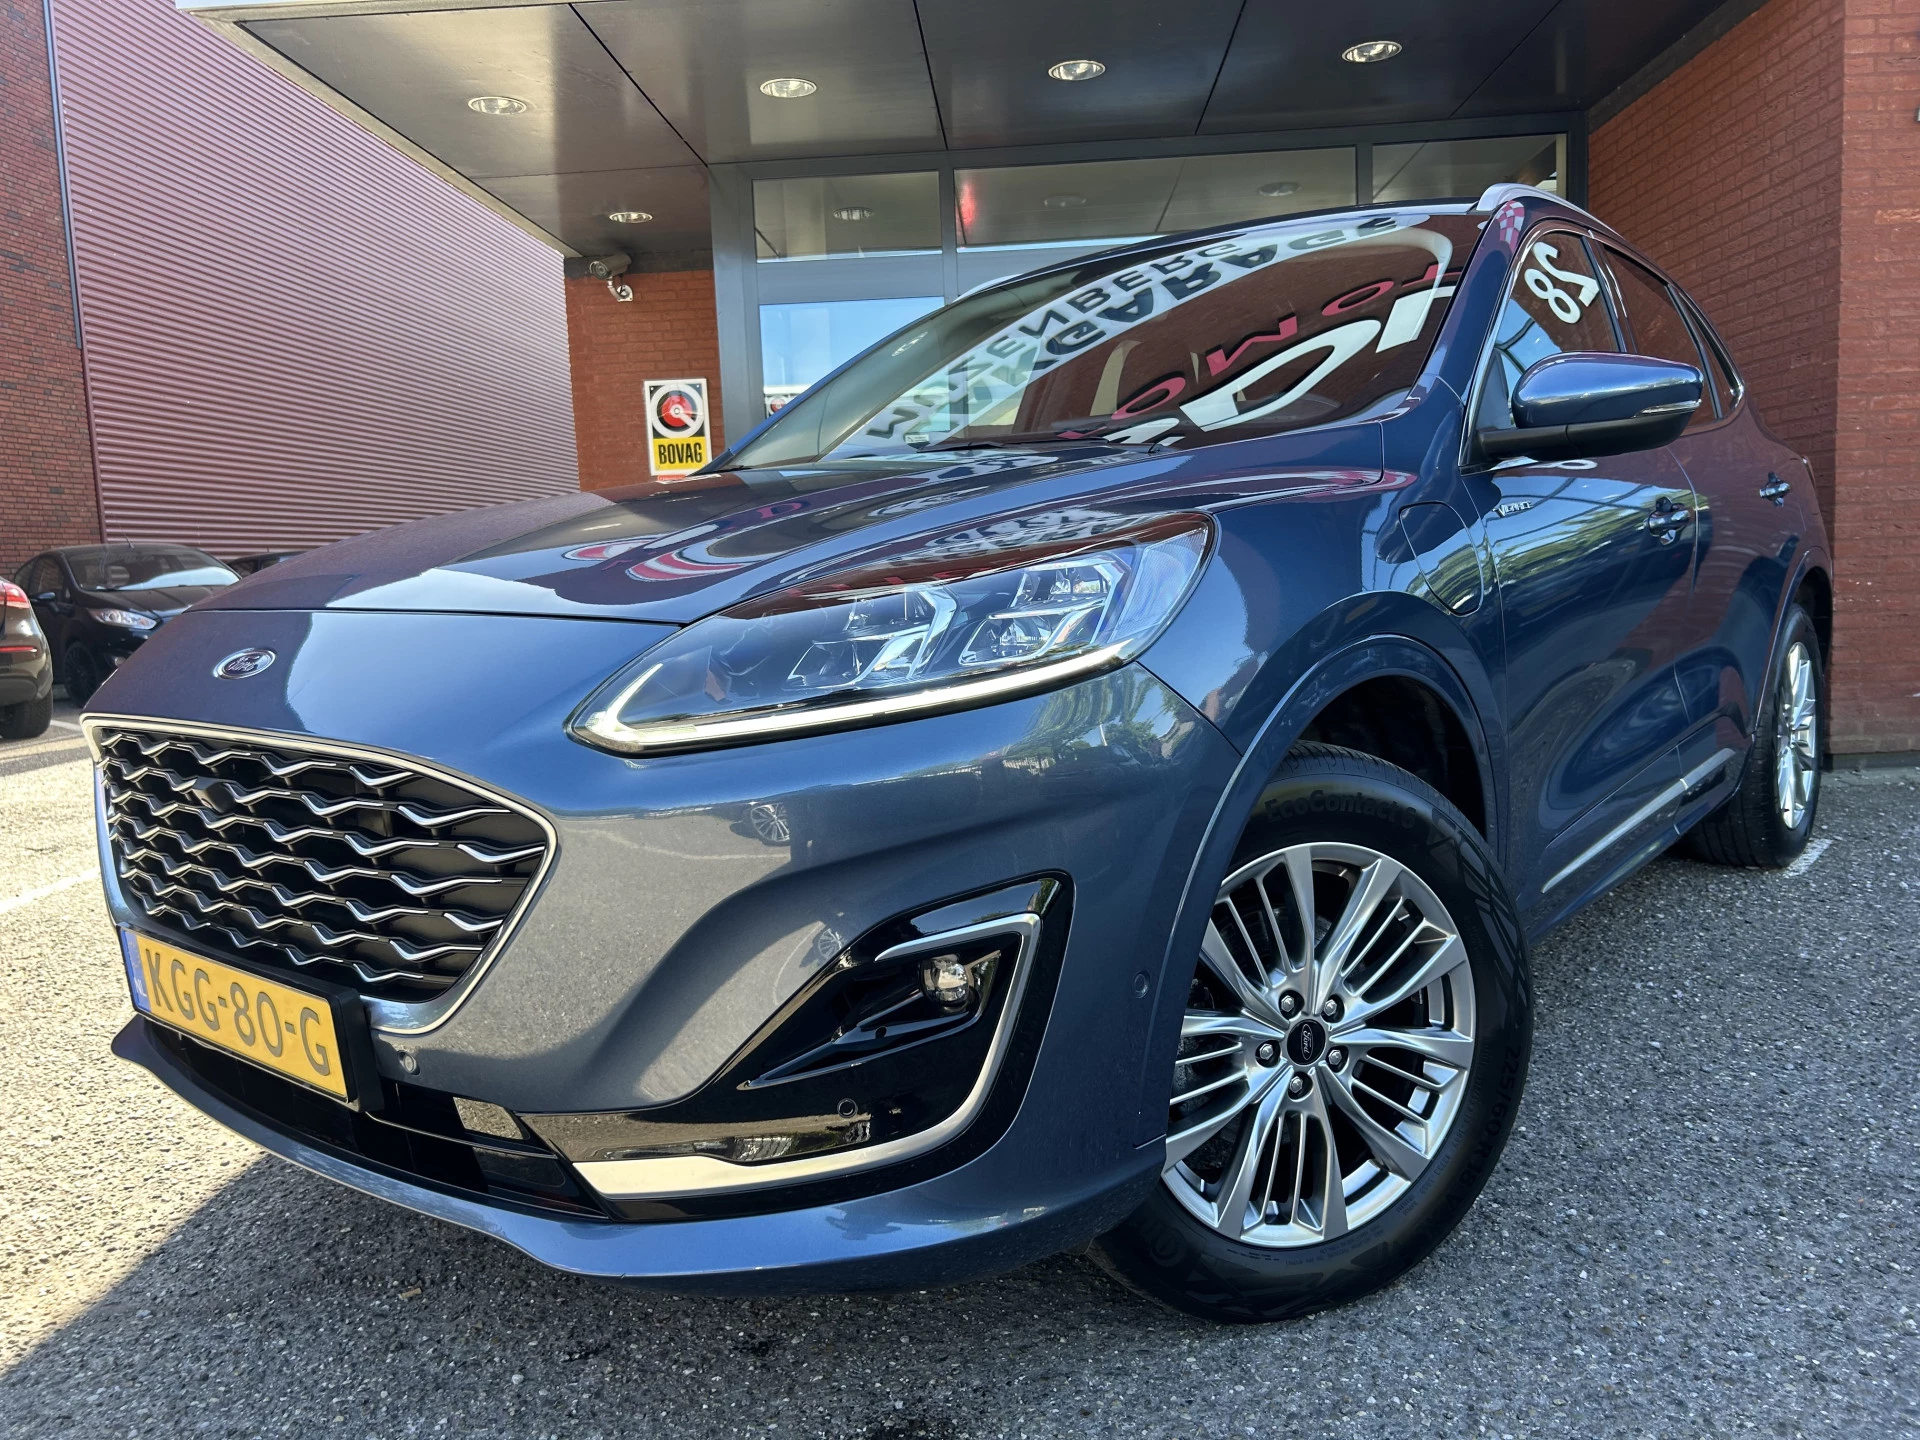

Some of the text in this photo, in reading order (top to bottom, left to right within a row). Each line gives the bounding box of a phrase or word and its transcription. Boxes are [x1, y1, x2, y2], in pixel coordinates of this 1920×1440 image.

[658, 442, 703, 465] BOVAG
[1264, 789, 1417, 829] EcoContact 6
[134, 977, 148, 998] NL
[145, 948, 331, 1076] KGG-80-G
